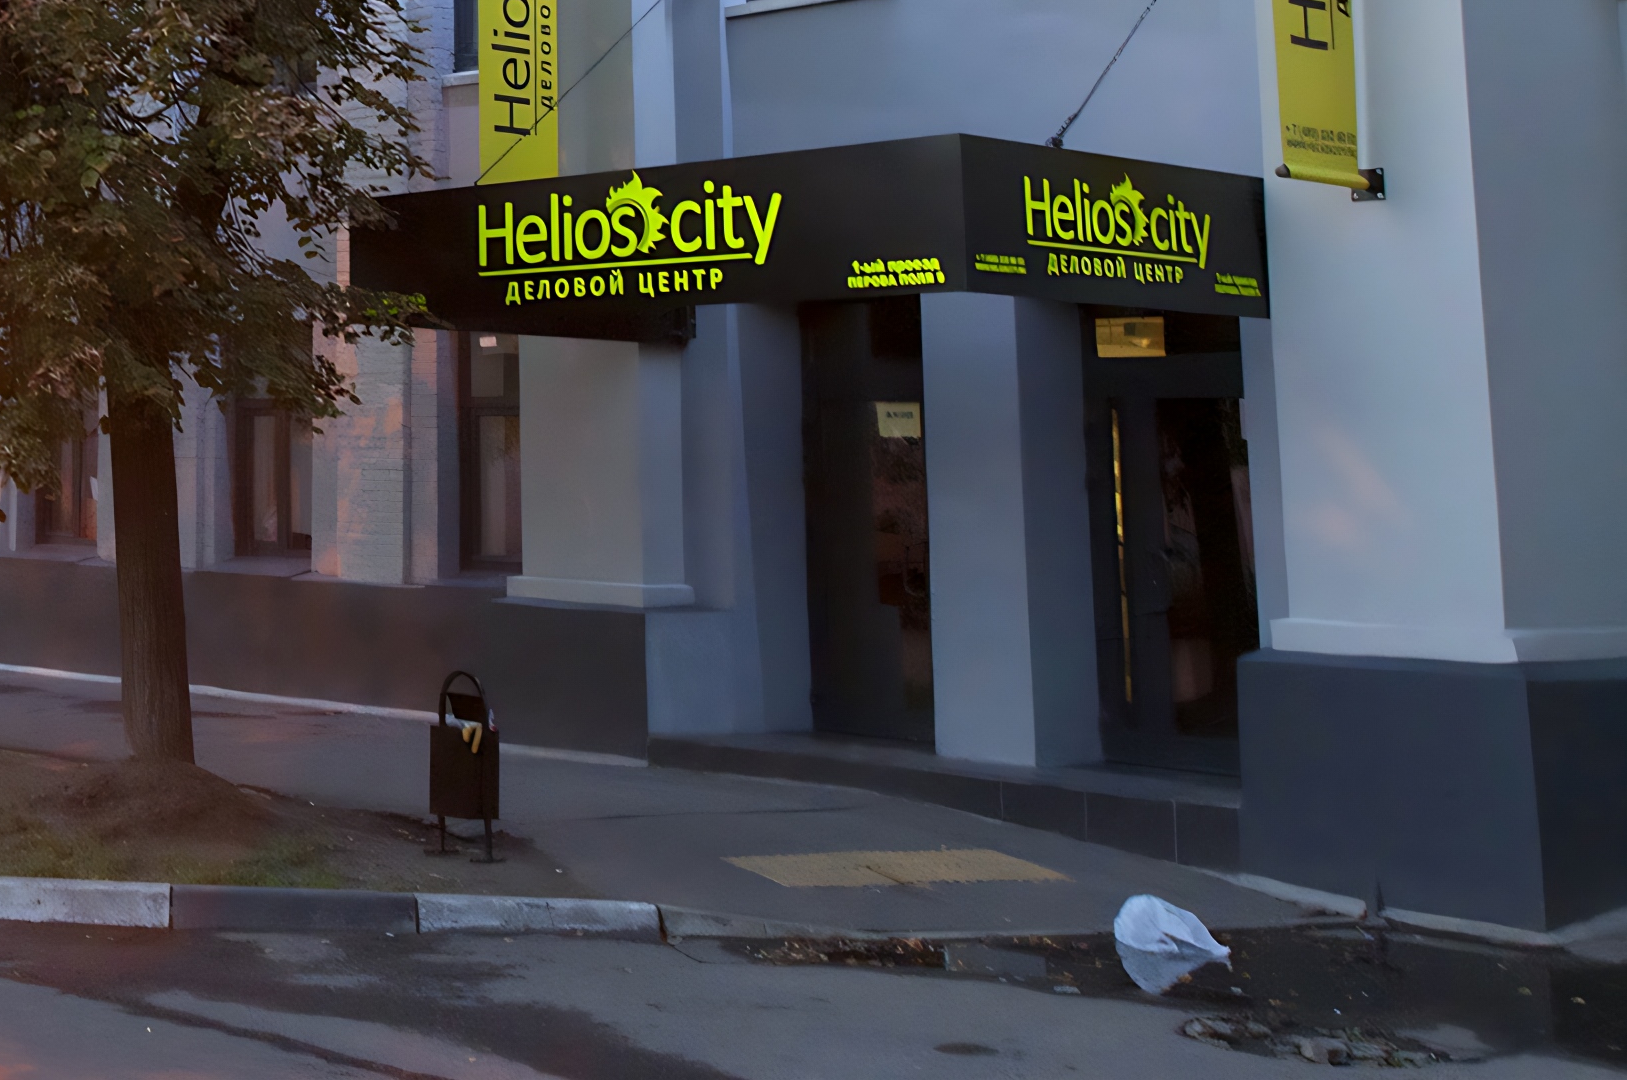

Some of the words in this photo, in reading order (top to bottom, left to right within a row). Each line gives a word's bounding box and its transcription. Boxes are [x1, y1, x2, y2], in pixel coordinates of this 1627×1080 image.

[478, 192, 637, 267] Helios
[670, 180, 782, 266] city
[1023, 175, 1133, 247] Helios
[1149, 193, 1211, 270] city
[505, 268, 625, 306] ДЕЛОВОЙ
[638, 267, 724, 298] ЦЕНТР
[1047, 251, 1128, 279] ДЕЛОВОЙ
[1133, 262, 1184, 285] ЦЕНТР
